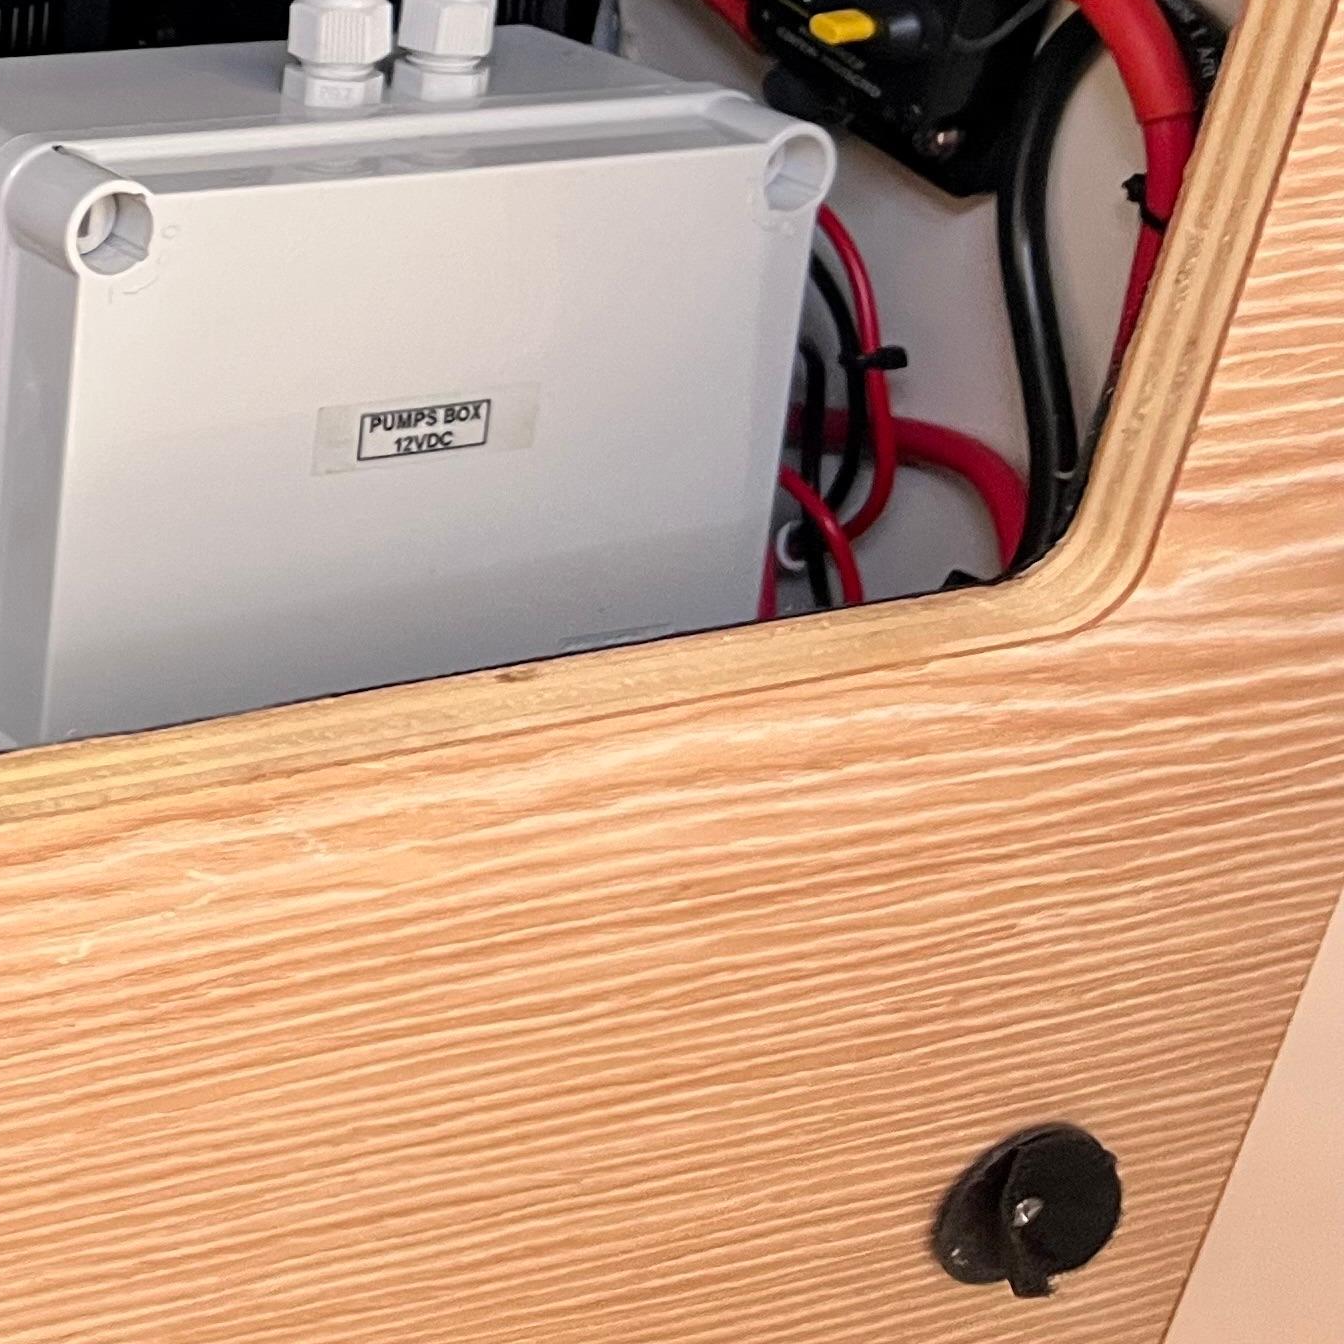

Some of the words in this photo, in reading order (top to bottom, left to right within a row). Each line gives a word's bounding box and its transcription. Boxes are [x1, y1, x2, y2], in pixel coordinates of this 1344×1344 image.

[368, 409, 438, 433] PUMPS
[443, 402, 482, 425] BOX
[394, 430, 455, 453] 12VDC
